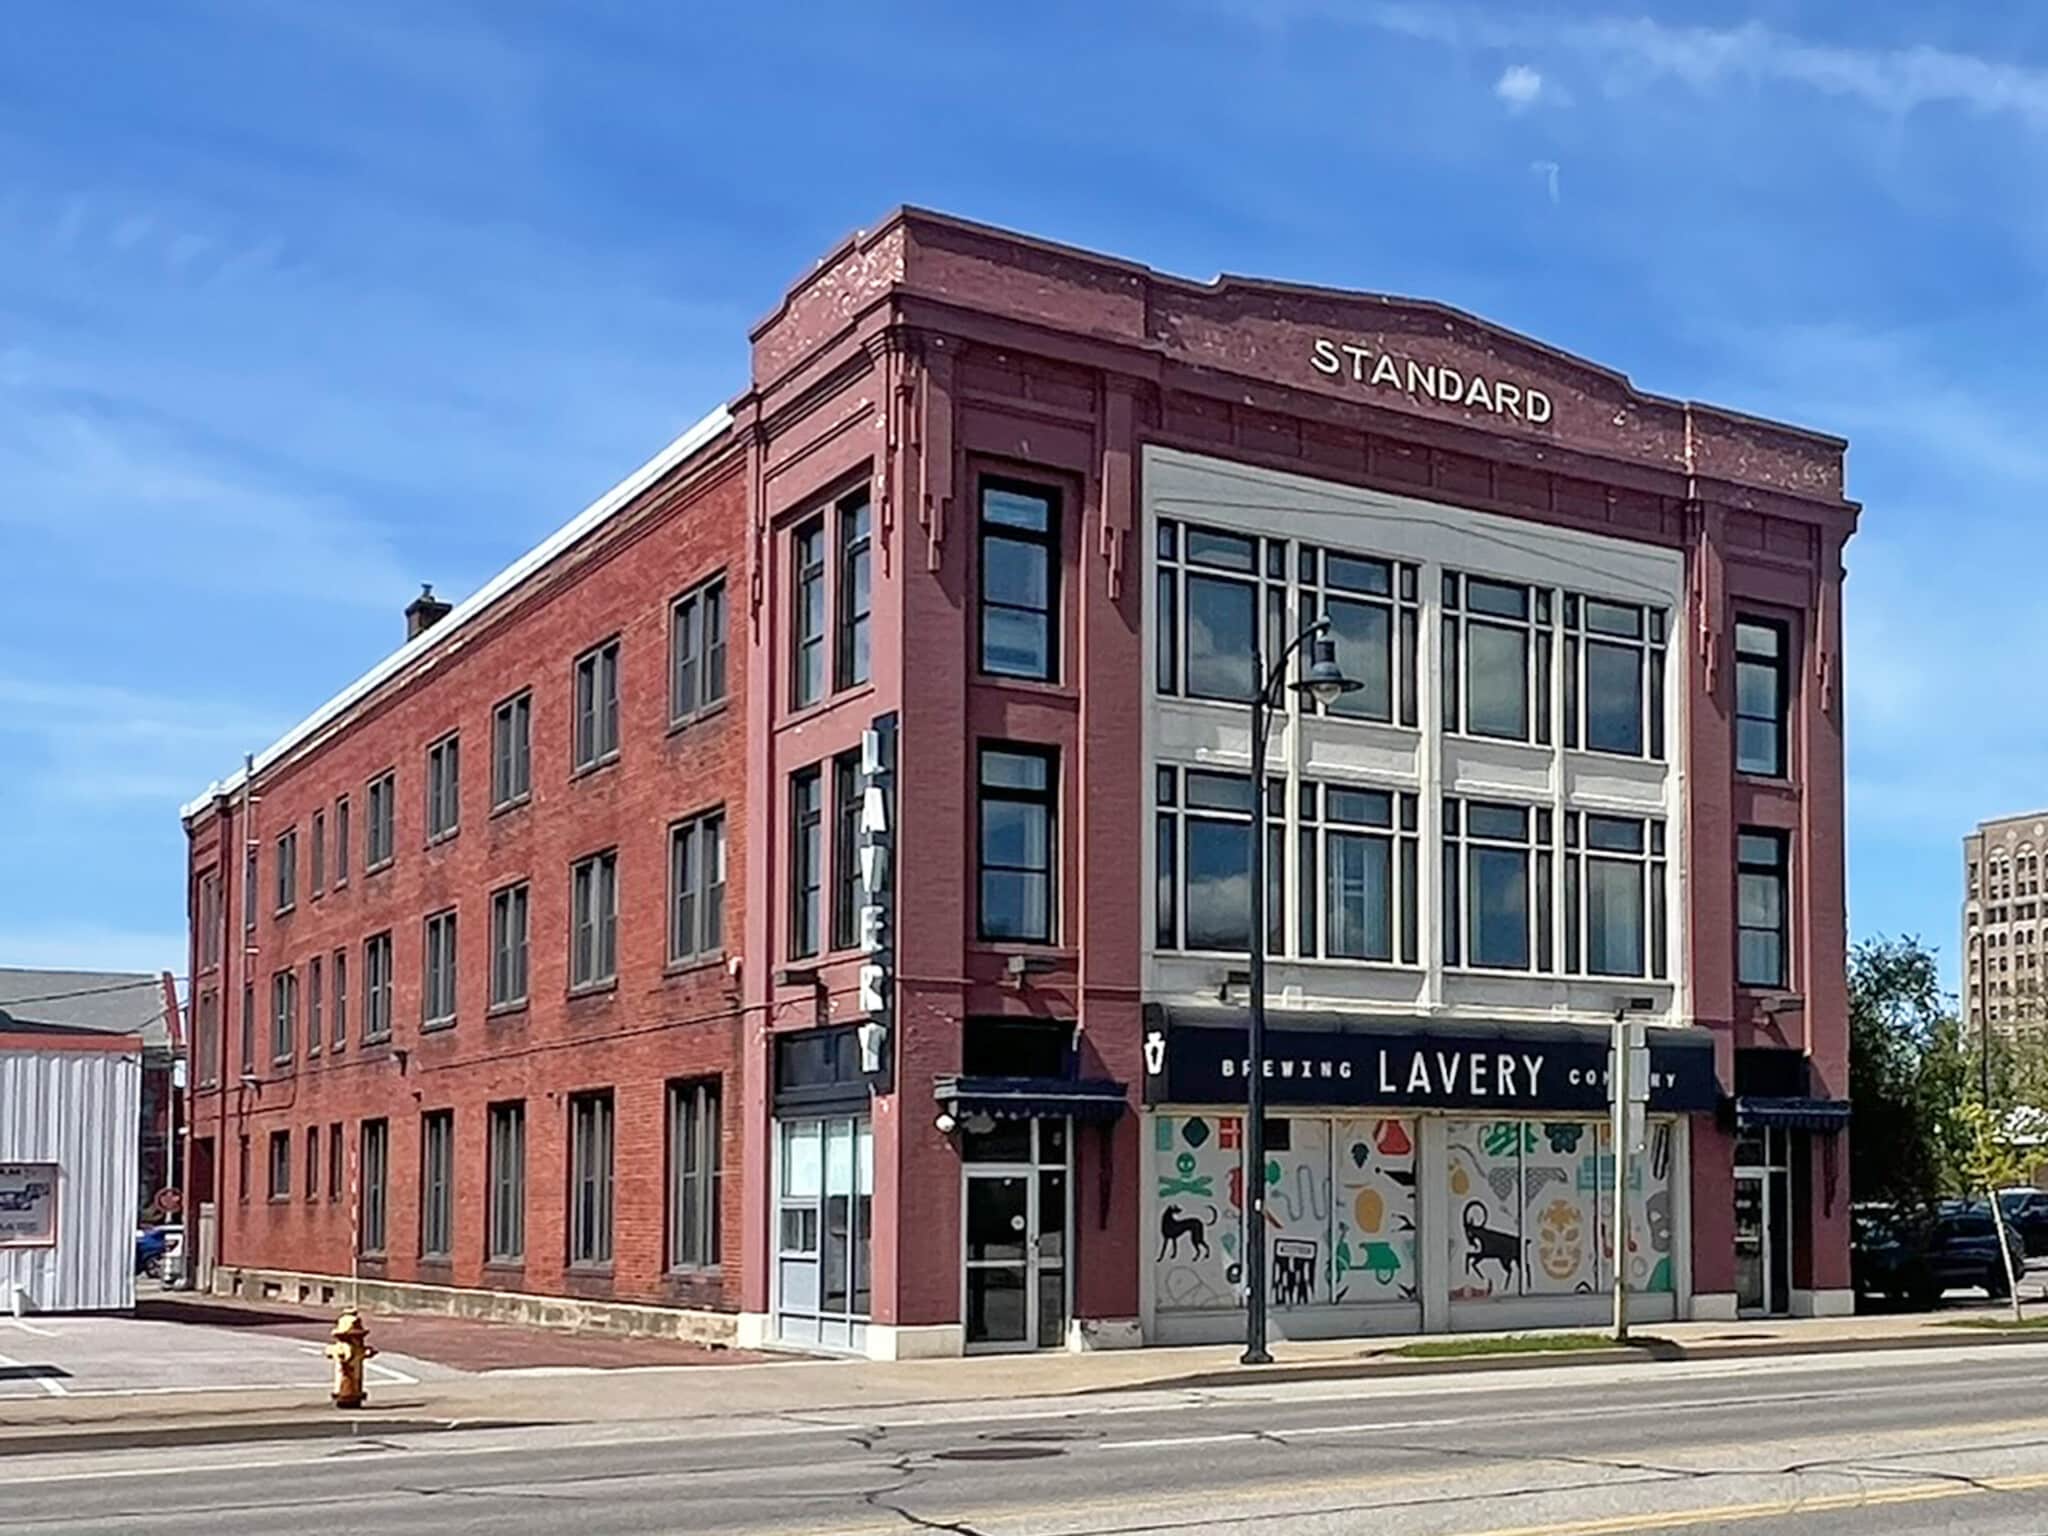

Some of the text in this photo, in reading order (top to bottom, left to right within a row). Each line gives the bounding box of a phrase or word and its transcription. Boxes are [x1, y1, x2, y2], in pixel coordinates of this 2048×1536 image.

[1310, 339, 1552, 423] STANDARD
[858, 729, 888, 1073] LAVERY
[1221, 1049, 1676, 1096] BREWING LAVERY CONY
